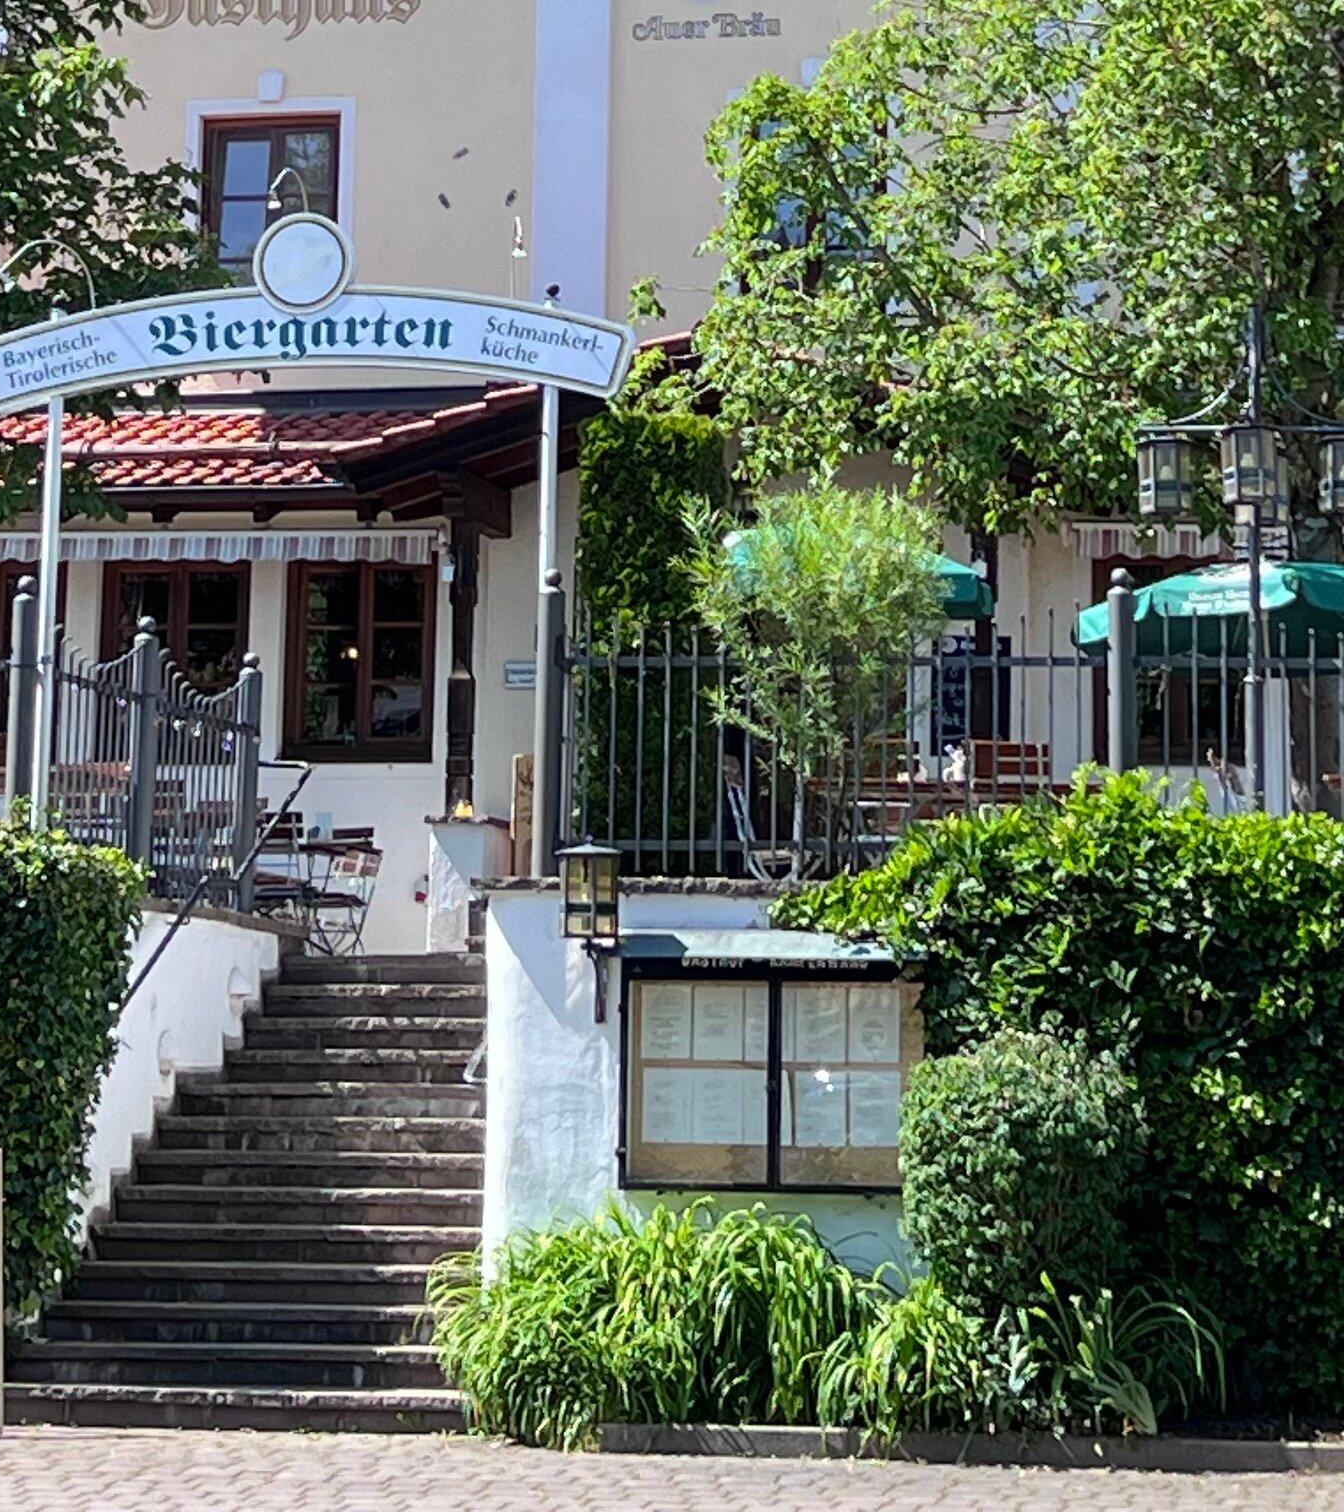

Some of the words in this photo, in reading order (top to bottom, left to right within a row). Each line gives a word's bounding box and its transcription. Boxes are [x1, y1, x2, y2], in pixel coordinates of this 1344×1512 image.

[2, 329, 102, 368] Bayerisch-
[148, 310, 454, 361] Biergarten
[480, 336, 539, 364] küche
[485, 315, 604, 353] Schmankerl-
[5, 349, 118, 389] Tirolerische
